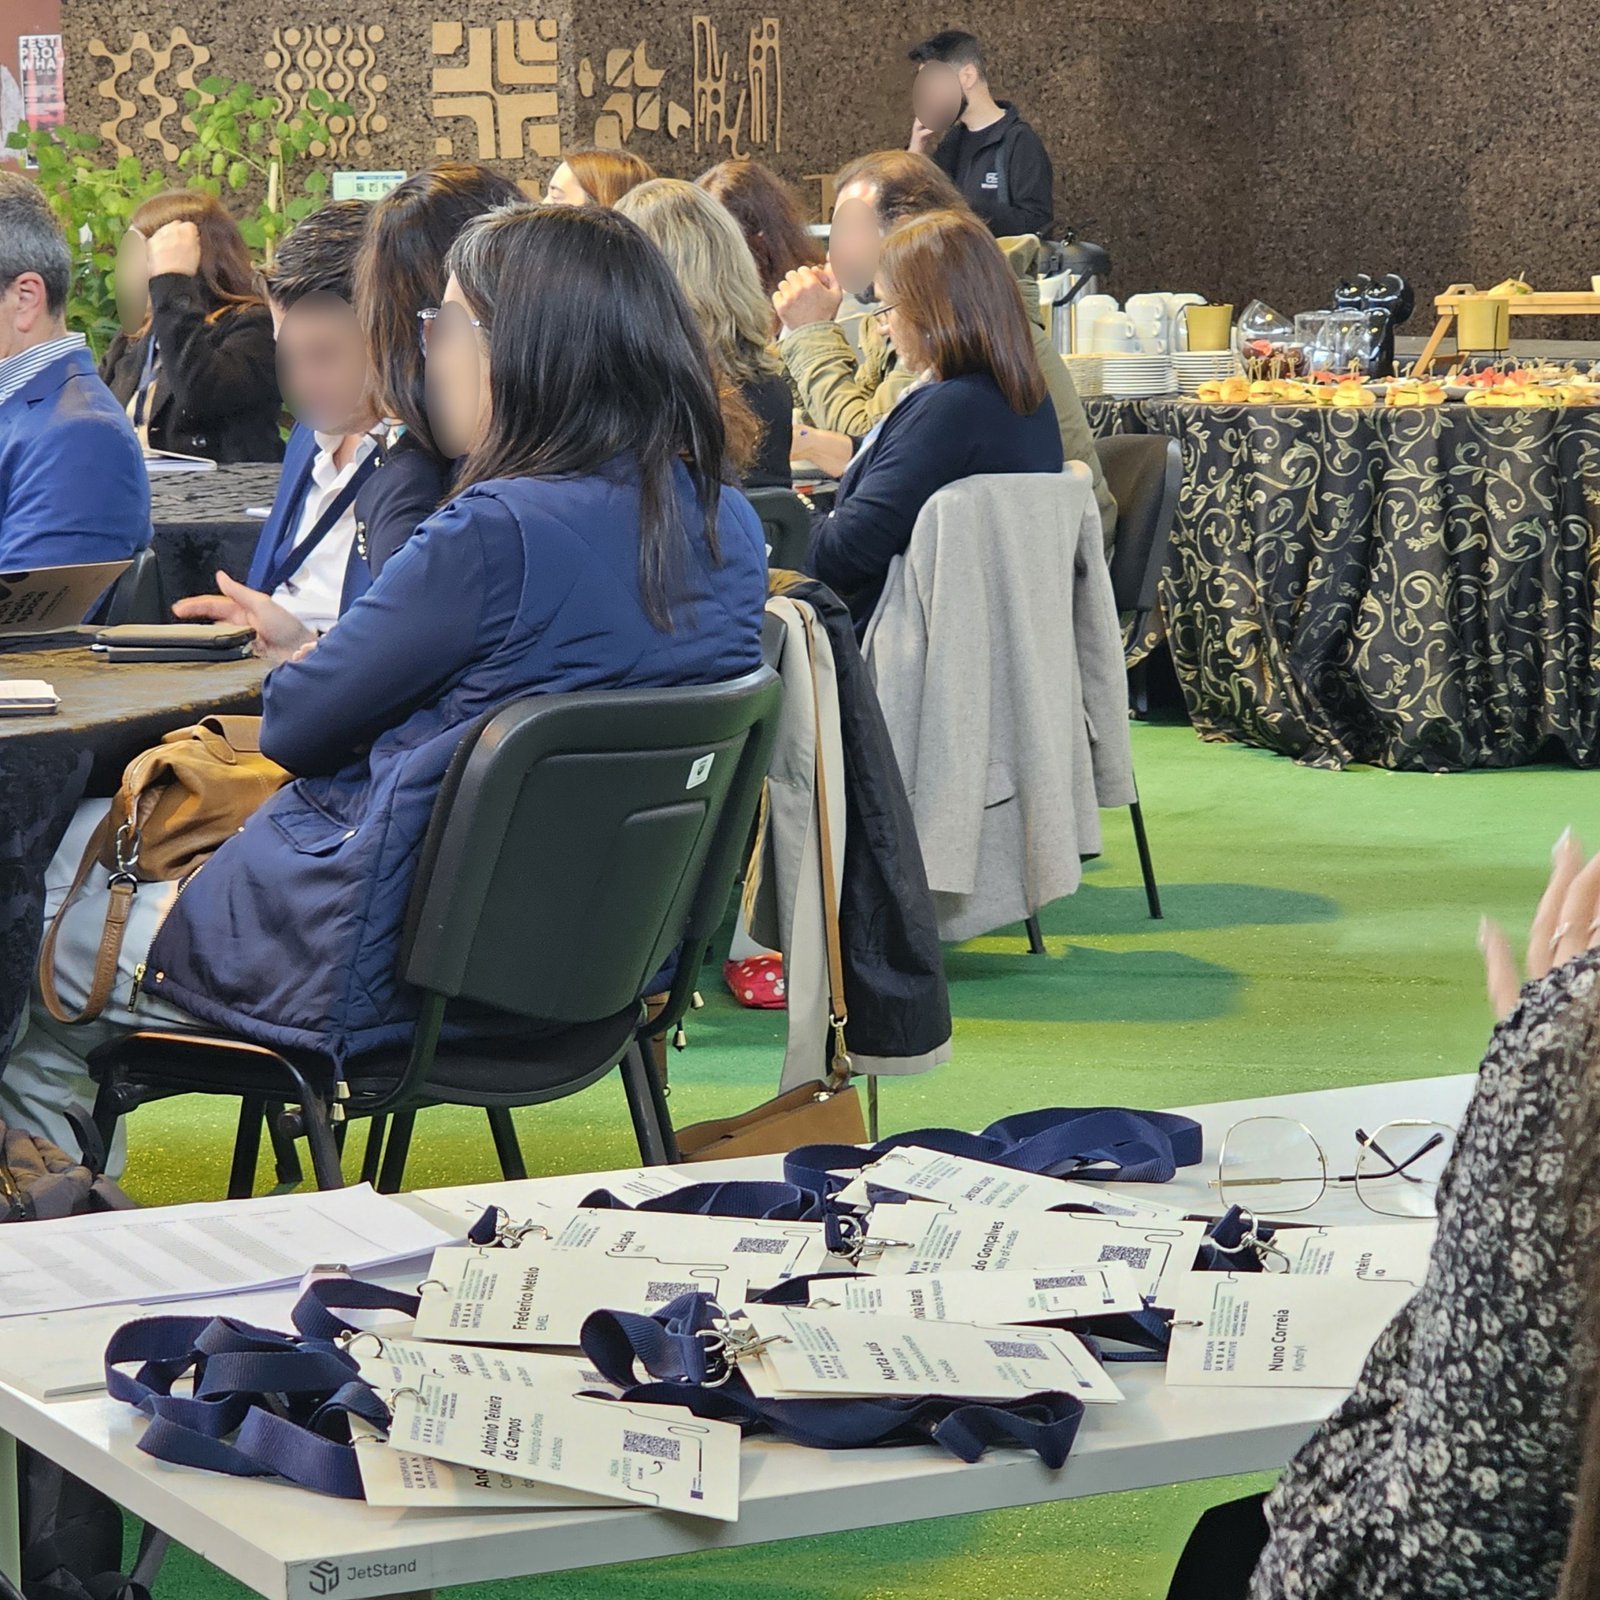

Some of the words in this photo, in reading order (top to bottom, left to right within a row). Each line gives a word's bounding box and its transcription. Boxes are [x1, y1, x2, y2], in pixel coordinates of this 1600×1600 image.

[611, 1231, 636, 1252] Calçada
[977, 1221, 1004, 1258] Gonçalves
[971, 1259, 987, 1272] do
[1355, 1253, 1373, 1276] nteiro
[520, 1267, 539, 1292] Metelo
[449, 1303, 462, 1328] EUROPEAN
[461, 1303, 473, 1328] URBAN
[472, 1304, 485, 1329] INITIATIVE
[512, 1293, 533, 1331] Frederico
[535, 1314, 549, 1331] EMEL
[1271, 1309, 1289, 1344] Correia
[892, 1347, 906, 1360] para
[1203, 1341, 1214, 1371] EUROPEAN
[1215, 1341, 1225, 1371] URBAN
[1226, 1341, 1237, 1371] INITIATIVE
[1268, 1345, 1286, 1371] Nuno
[1292, 1345, 1308, 1371] Kyndryl
[807, 1354, 827, 1379] EUROPEAN
[818, 1354, 838, 1379] URBAN
[829, 1355, 850, 1379] INITIATIVE
[876, 1357, 899, 1381] Marta
[483, 1395, 503, 1421] Teixeira
[421, 1418, 434, 1444] URBAN
[479, 1423, 500, 1457] António
[502, 1417, 524, 1448] Campos
[500, 1449, 518, 1461] de
[548, 1437, 563, 1462] Lanhoso
[399, 1457, 413, 1489] EUROPEAN
[410, 1457, 426, 1489] URBAN
[422, 1456, 438, 1489] INITIATIVE
[469, 1468, 491, 1489] And
[548, 1462, 560, 1471] de
[346, 1558, 417, 1581] JetStand
